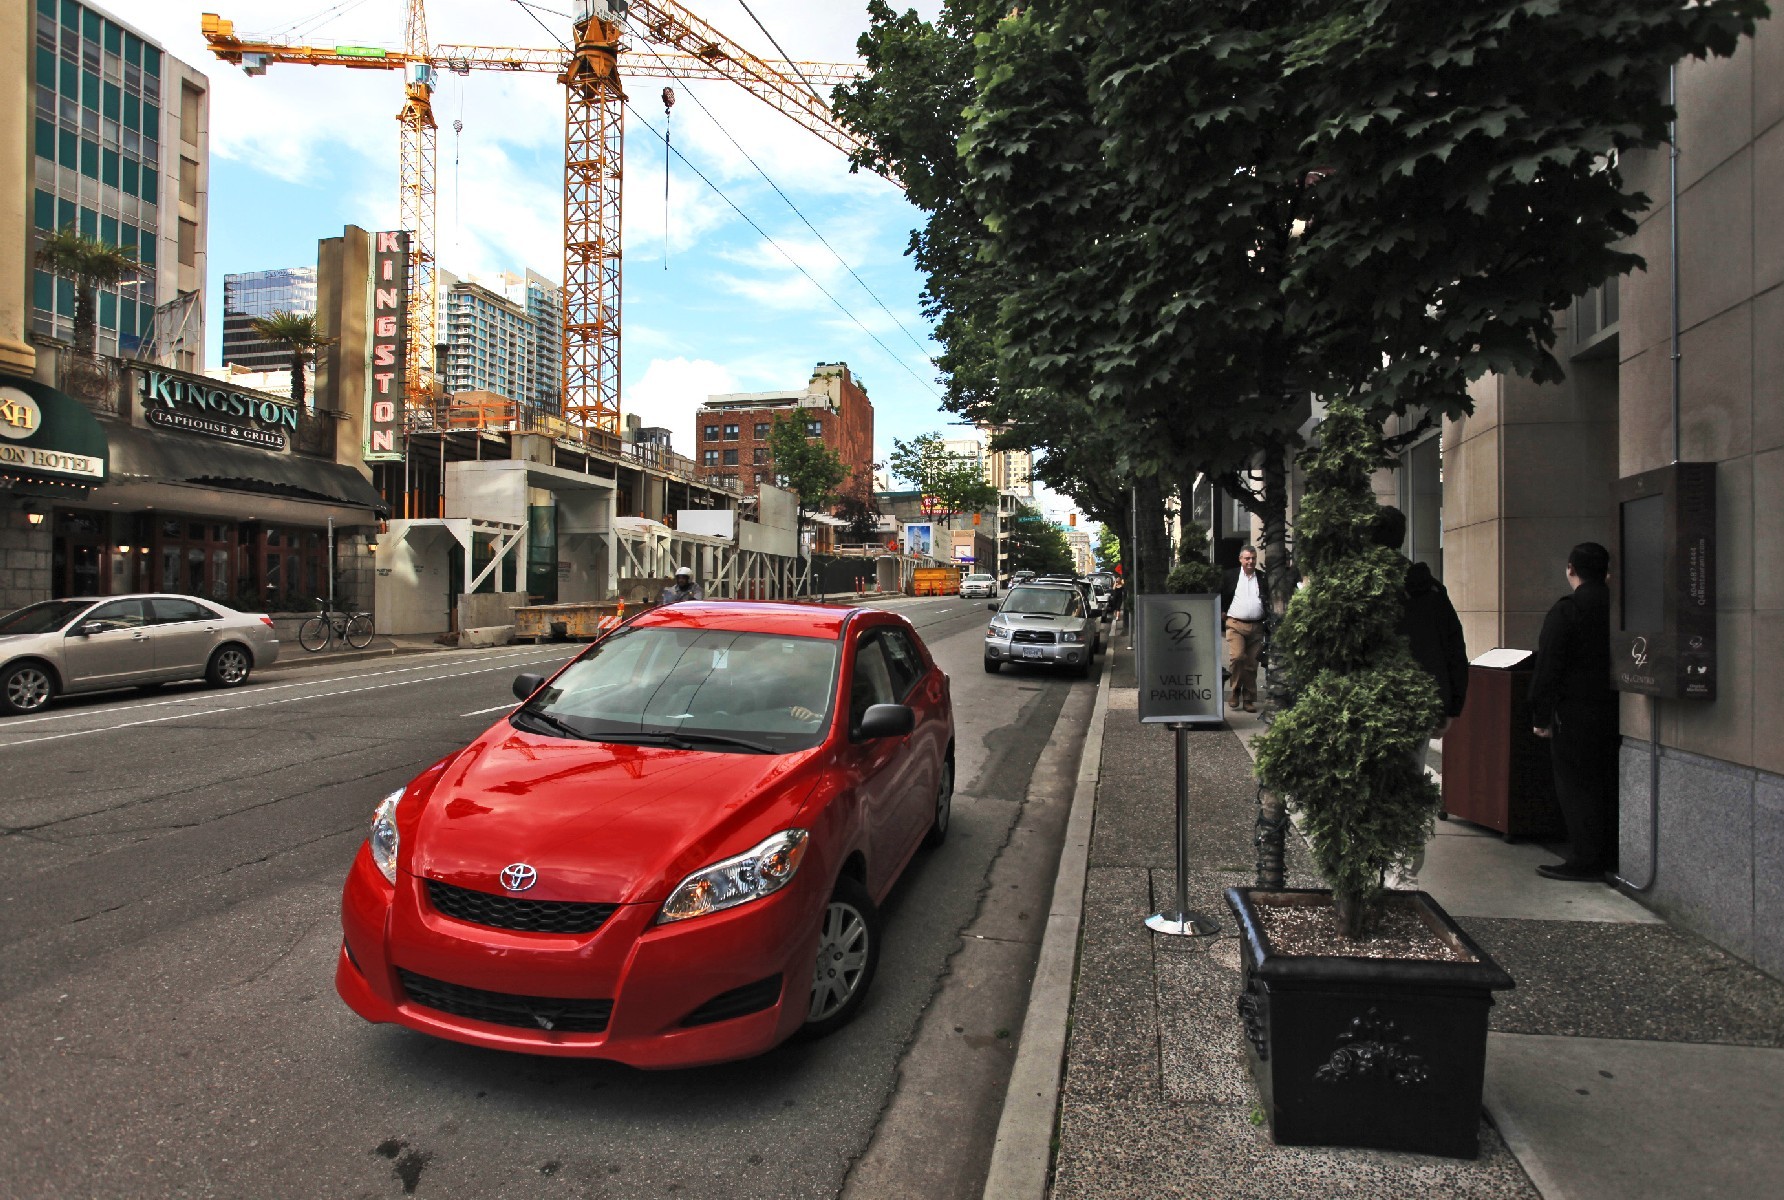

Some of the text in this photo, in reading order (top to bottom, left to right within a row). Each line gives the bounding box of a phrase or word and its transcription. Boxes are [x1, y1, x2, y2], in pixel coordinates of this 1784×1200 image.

[373, 231, 400, 451] KINGSTON
[149, 371, 298, 431] KINGSTON
[156, 411, 284, 445] TAPHOUSE & GRILLE
[32, 450, 95, 473] HOTEL
[1160, 674, 1203, 686] VALET
[1150, 688, 1212, 701] PARKING
